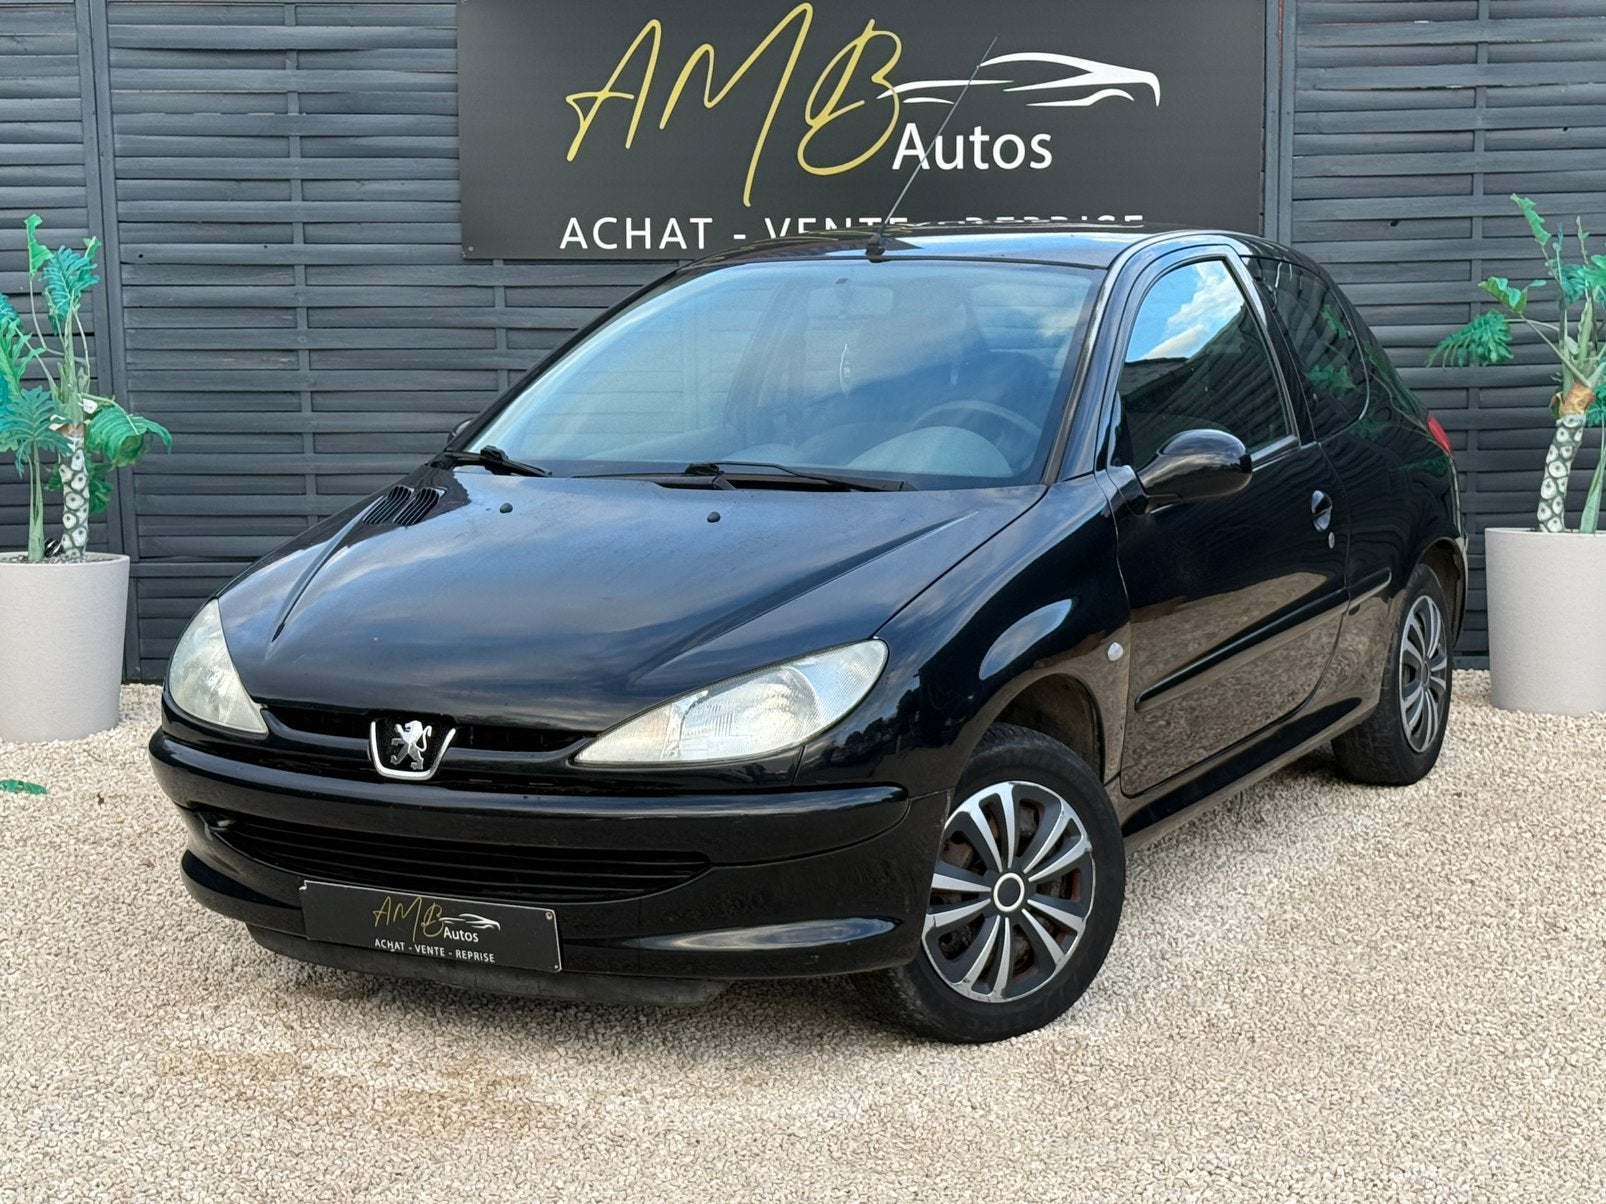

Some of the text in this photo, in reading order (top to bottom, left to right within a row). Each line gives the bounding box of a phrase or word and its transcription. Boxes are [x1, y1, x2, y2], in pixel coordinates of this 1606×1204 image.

[565, 2, 1053, 208] AMB Autos
[559, 217, 713, 250] ACHAT
[373, 896, 479, 943] AMB Autos
[374, 938, 405, 951] ACHAT
[415, 944, 445, 957] VENTE
[455, 949, 496, 963] REPRISE
